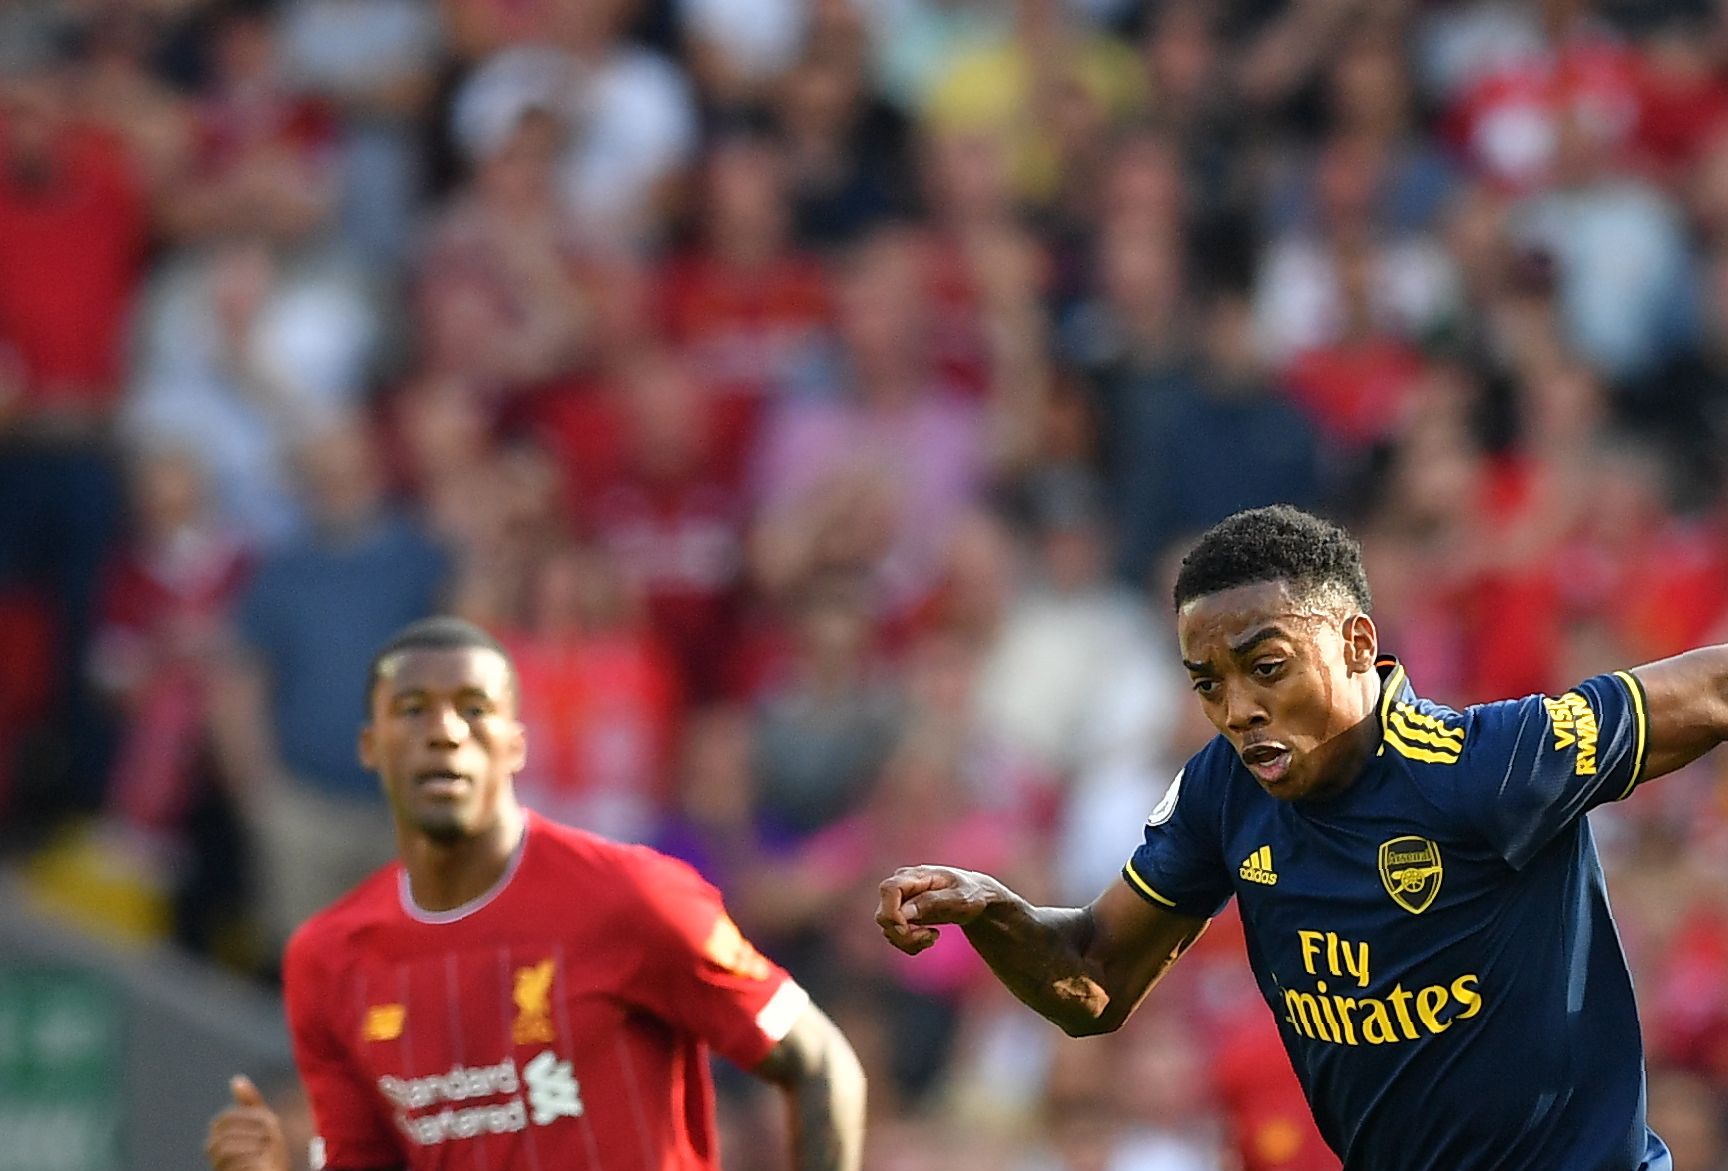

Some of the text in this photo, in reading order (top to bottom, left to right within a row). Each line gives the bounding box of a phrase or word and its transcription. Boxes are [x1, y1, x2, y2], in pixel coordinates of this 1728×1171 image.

[1239, 867, 1278, 885] adidas
[1388, 849, 1432, 866] Arsenal
[1298, 930, 1370, 987] Fly
[1272, 973, 1482, 1046] mirates
